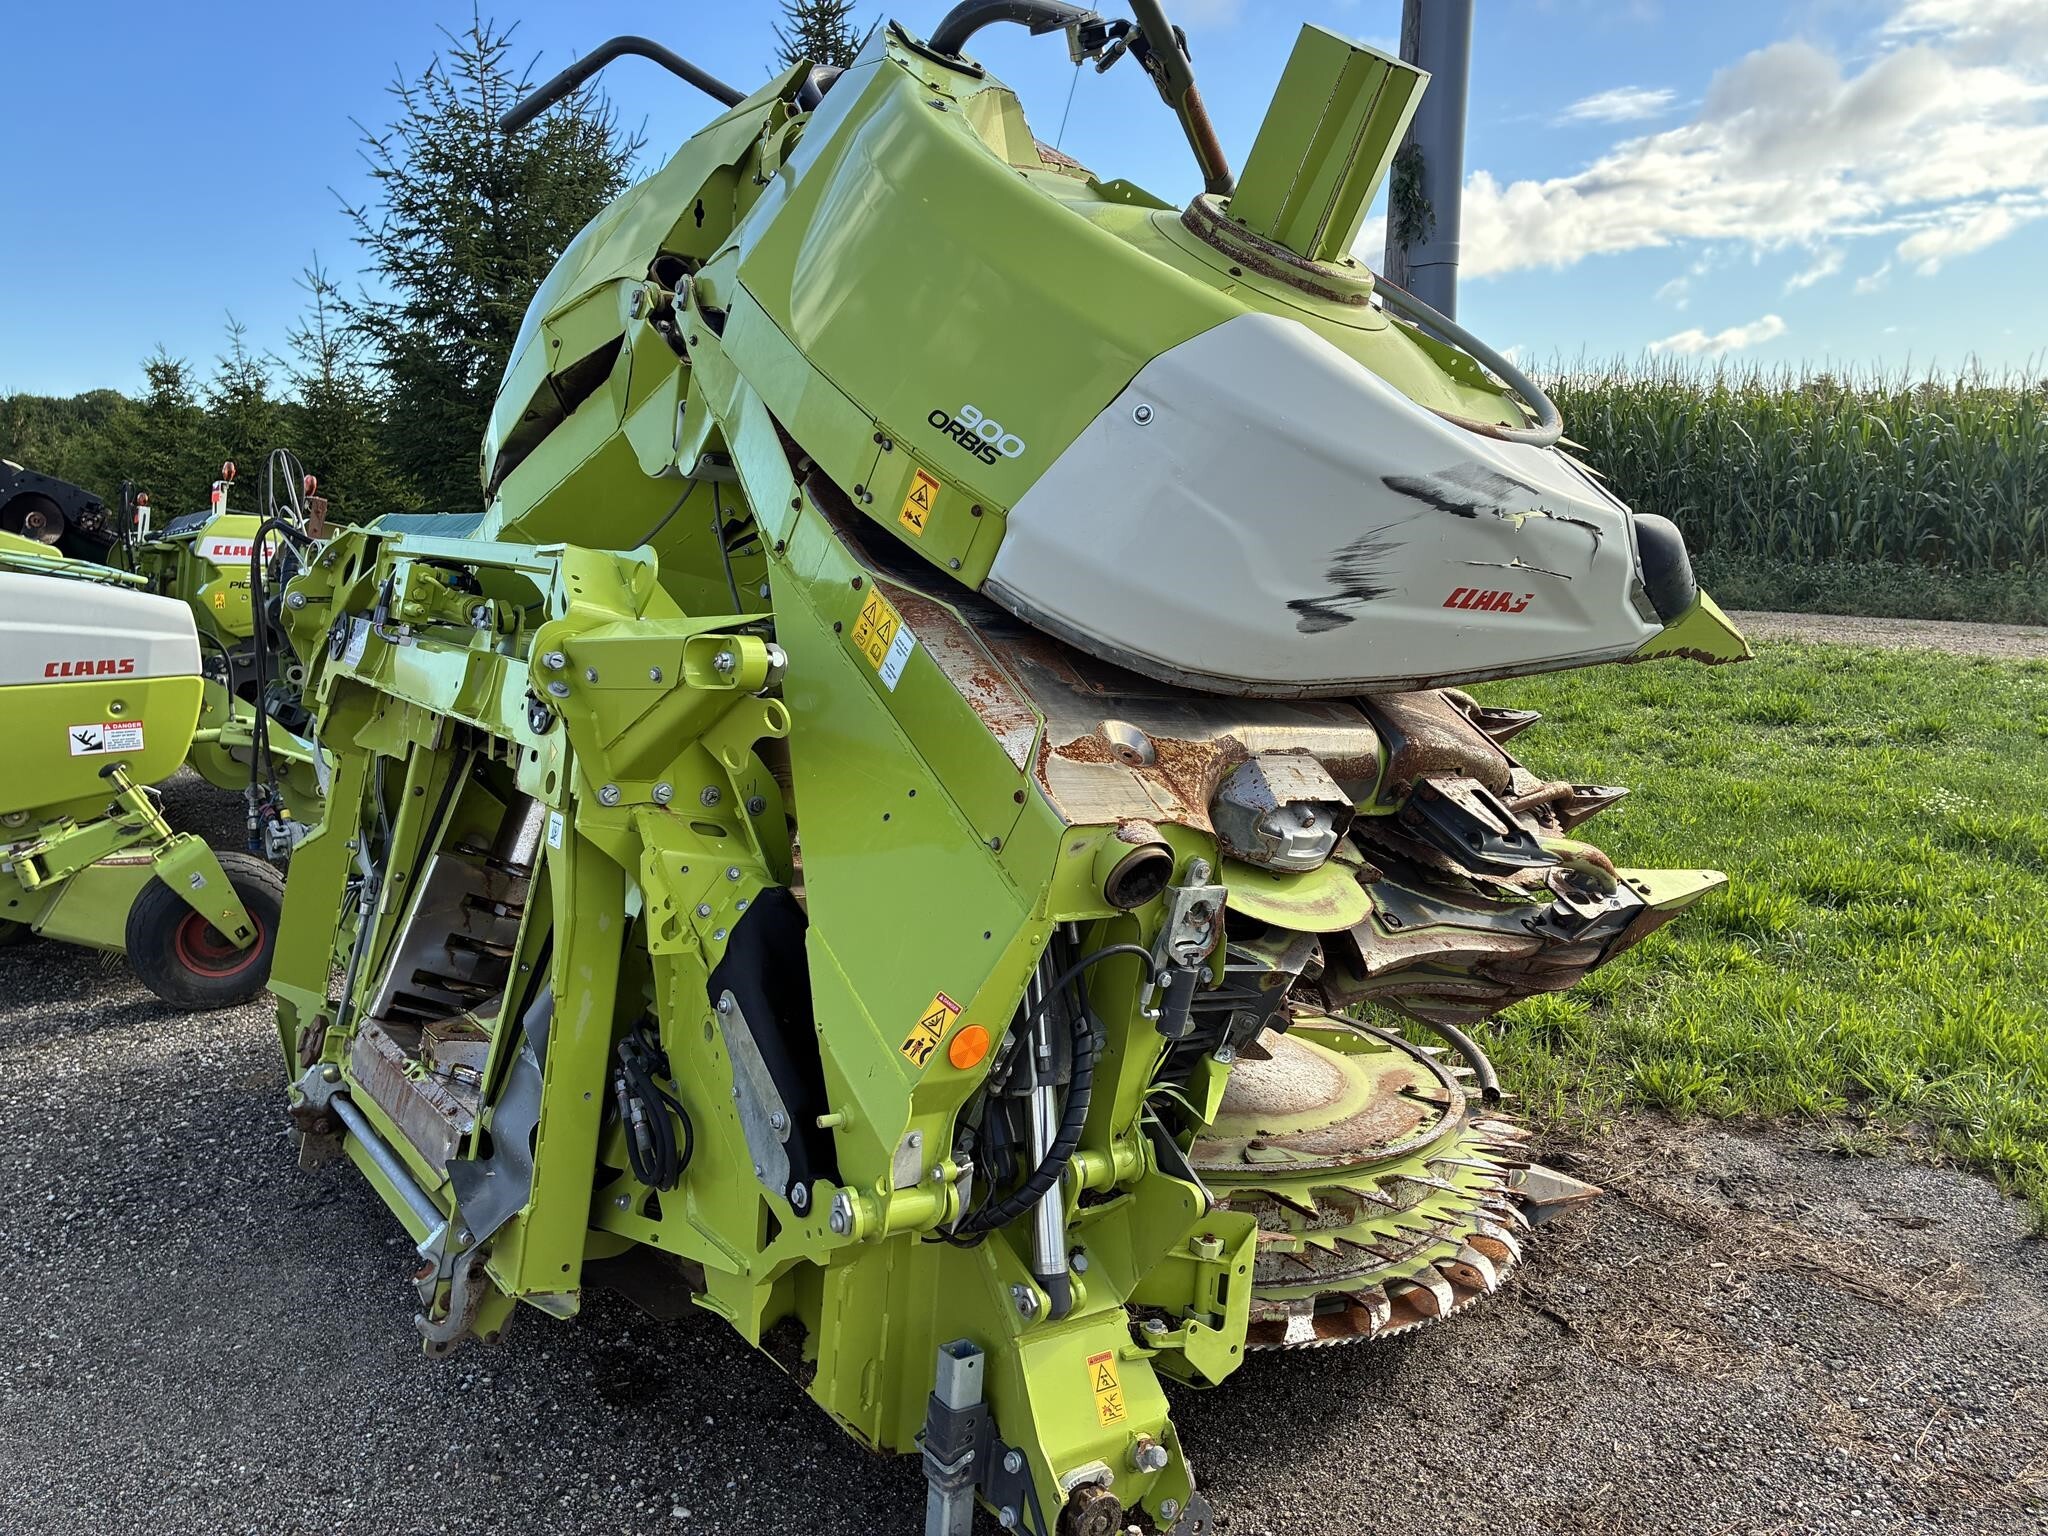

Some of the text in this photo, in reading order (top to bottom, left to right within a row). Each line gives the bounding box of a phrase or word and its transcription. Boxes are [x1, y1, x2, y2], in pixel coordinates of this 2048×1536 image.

[927, 409, 1003, 466] ORBIS
[954, 404, 1025, 458] 900
[229, 581, 252, 589] PIC
[1442, 587, 1536, 613] CLAAS
[44, 658, 135, 678] CLAAS
[112, 722, 142, 730] DANGER
